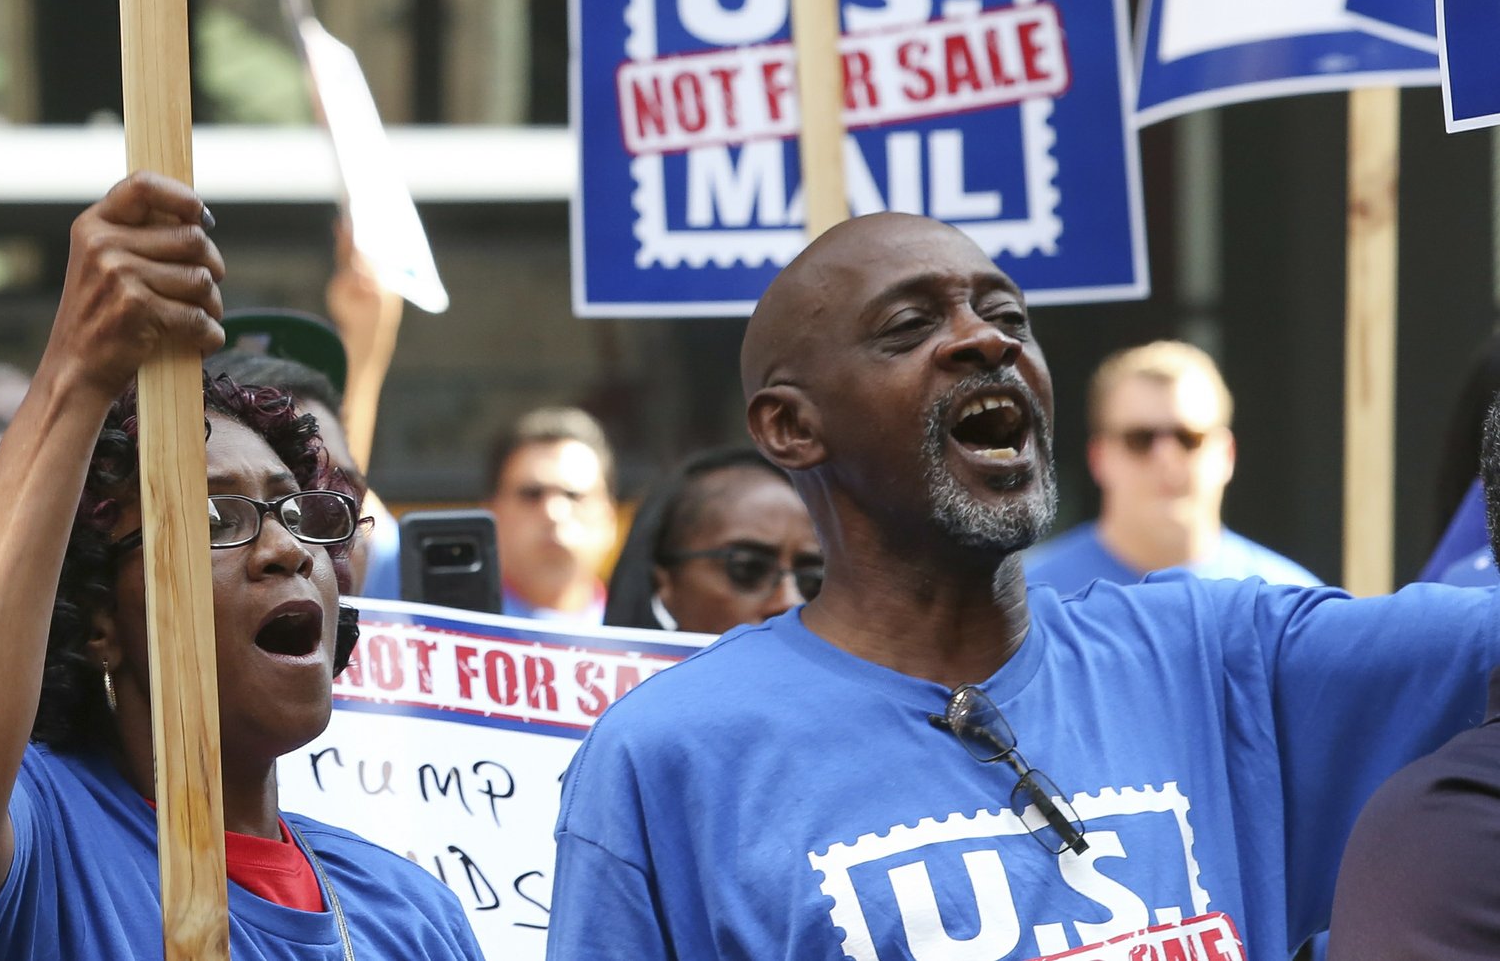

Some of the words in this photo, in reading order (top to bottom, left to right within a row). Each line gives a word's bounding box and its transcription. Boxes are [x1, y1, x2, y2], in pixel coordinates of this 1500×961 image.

[631, 68, 740, 139] NOT
[761, 47, 879, 122] FR
[898, 21, 1053, 103] SALE
[455, 645, 559, 712] FOR
[575, 659, 662, 718] SA
